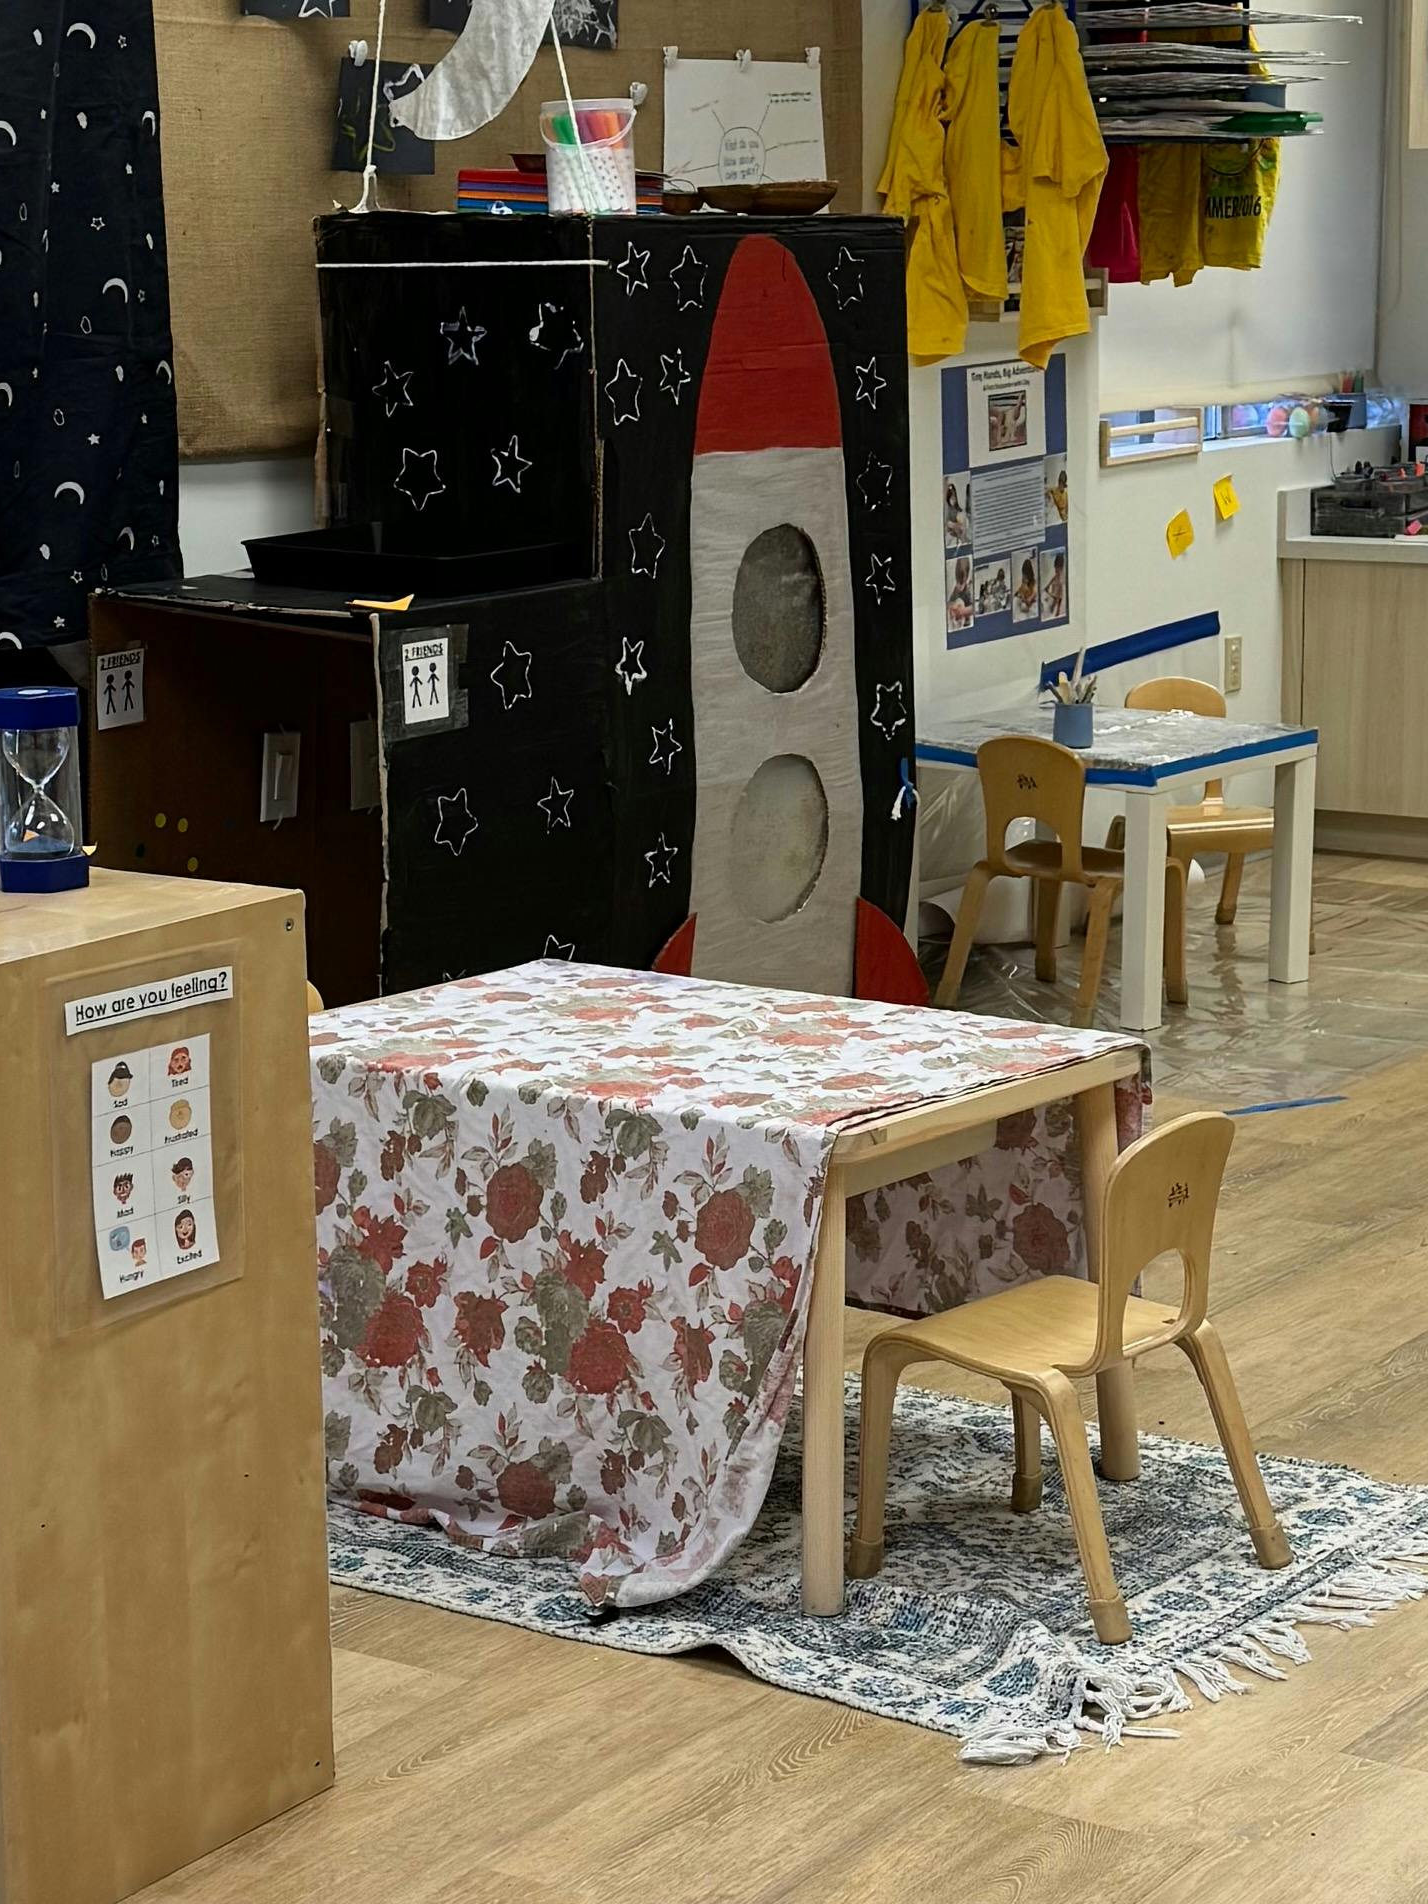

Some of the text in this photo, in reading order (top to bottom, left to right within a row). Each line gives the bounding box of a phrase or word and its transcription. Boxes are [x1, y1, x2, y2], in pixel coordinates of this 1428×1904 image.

[75, 970, 229, 1022] How are you feeling?
